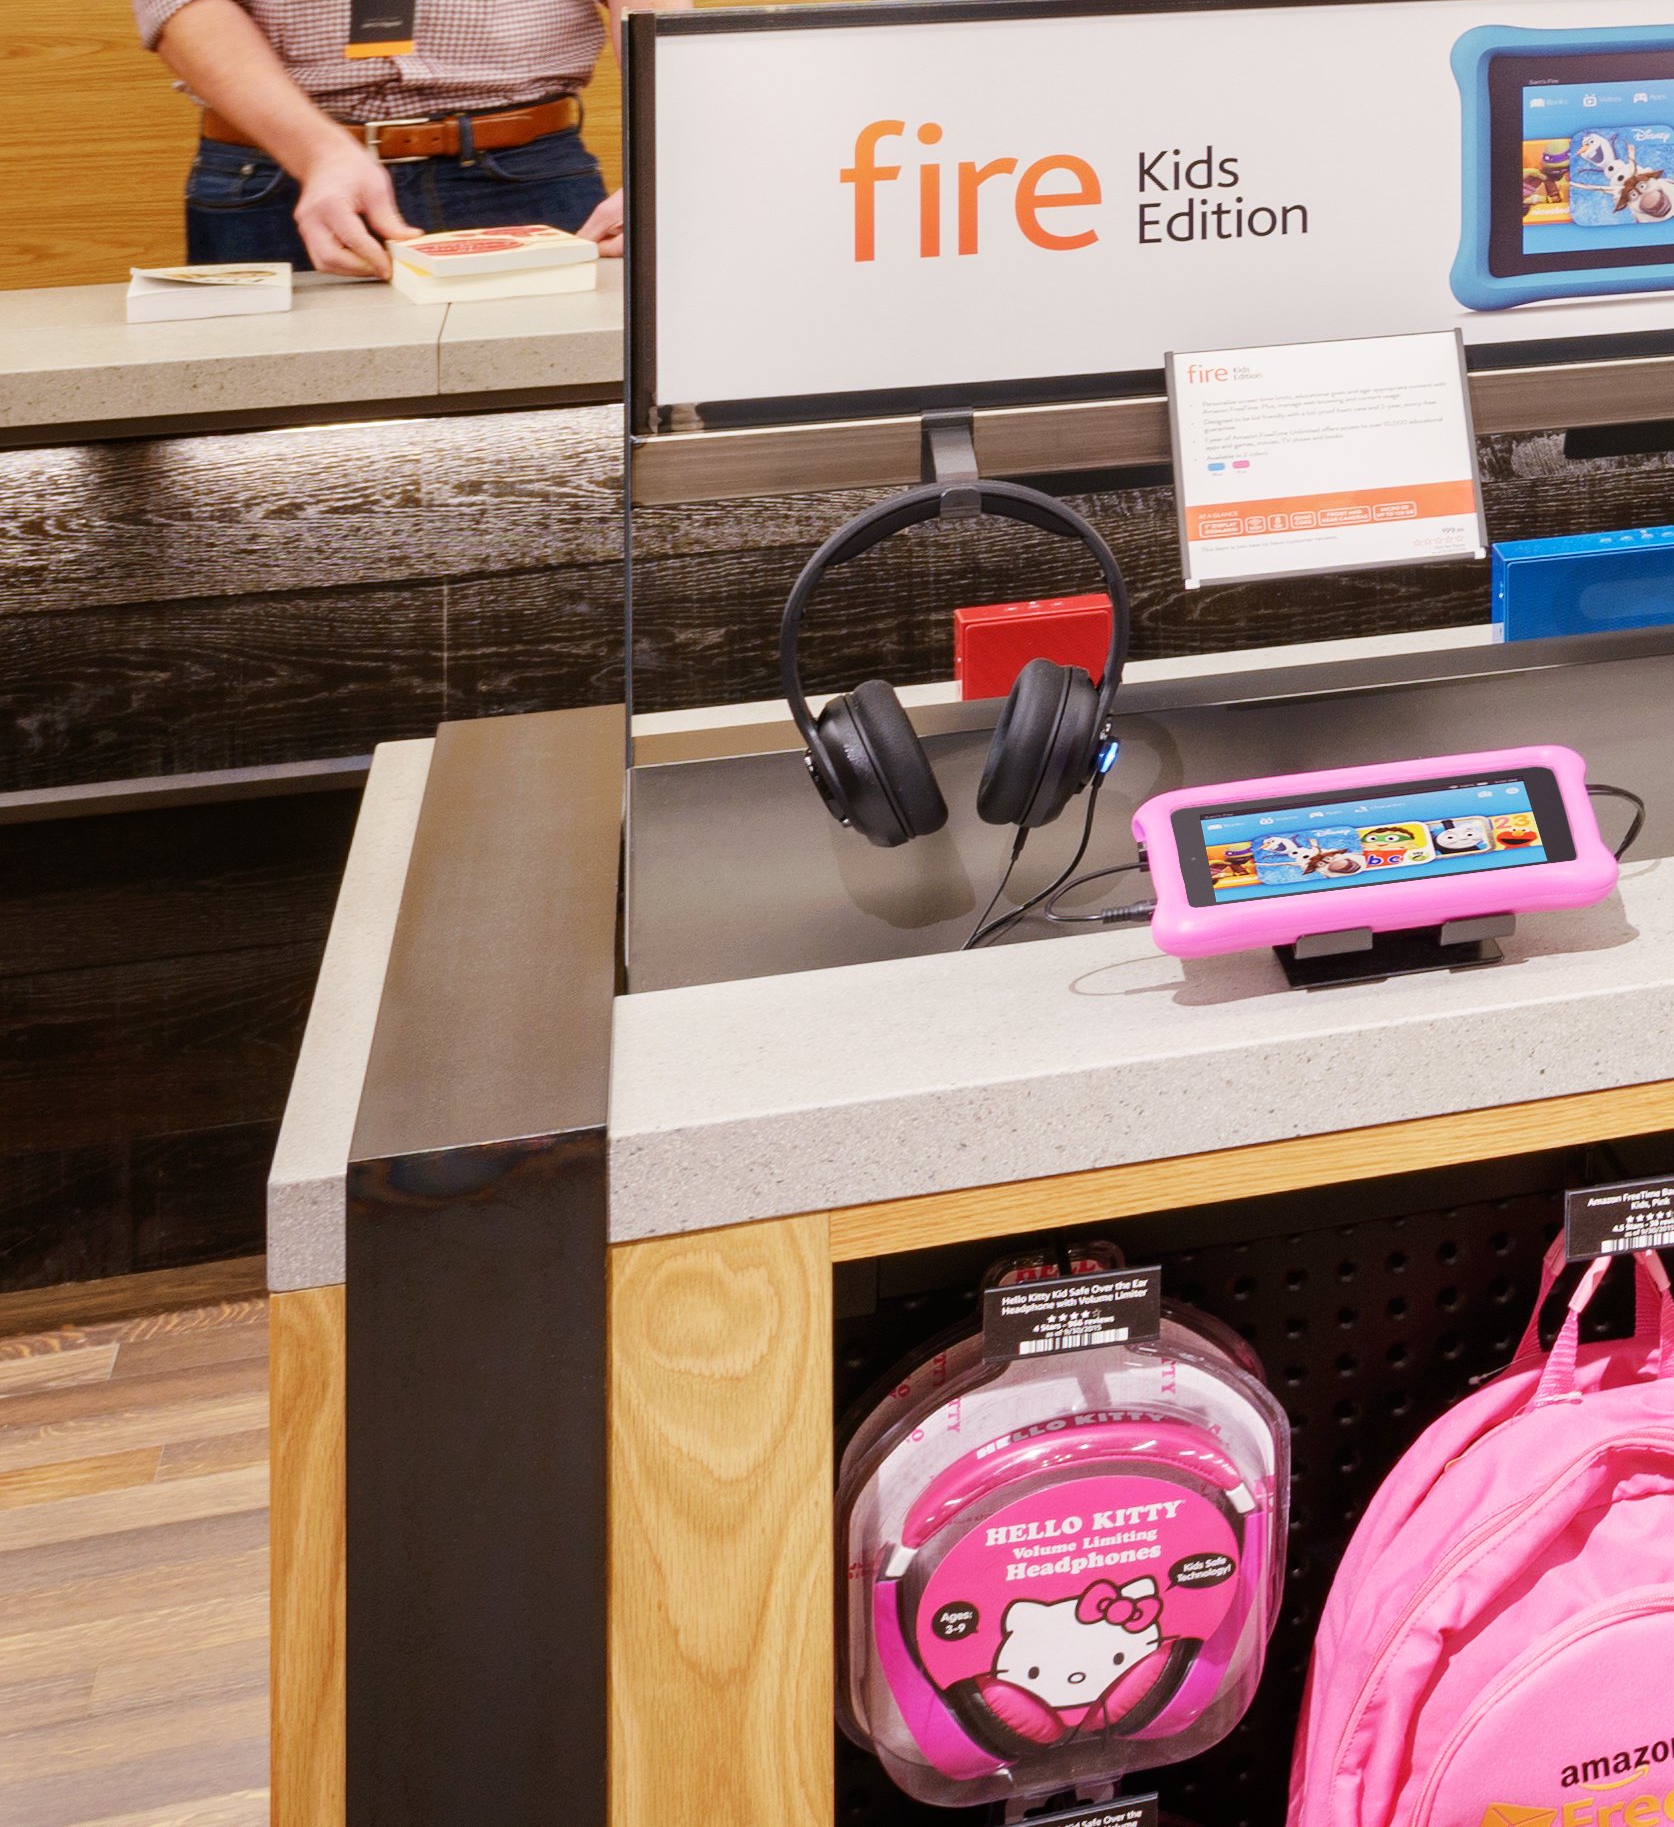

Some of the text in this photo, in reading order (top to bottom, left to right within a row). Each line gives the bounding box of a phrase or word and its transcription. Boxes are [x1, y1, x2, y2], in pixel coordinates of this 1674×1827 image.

[1138, 146, 1239, 193] Kids
[839, 119, 1102, 263] fire
[1138, 195, 1308, 244] Edition
[986, 1500, 1182, 1546] HELLO KITTY
[1013, 1528, 1158, 1560] Volume Limiting
[1005, 1545, 1161, 1581] Headphones
[1177, 1564, 1231, 1582] Technology!
[1182, 1556, 1226, 1573] Kids Safe
[940, 1611, 973, 1623] Ages:
[946, 1624, 966, 1634] 3-9
